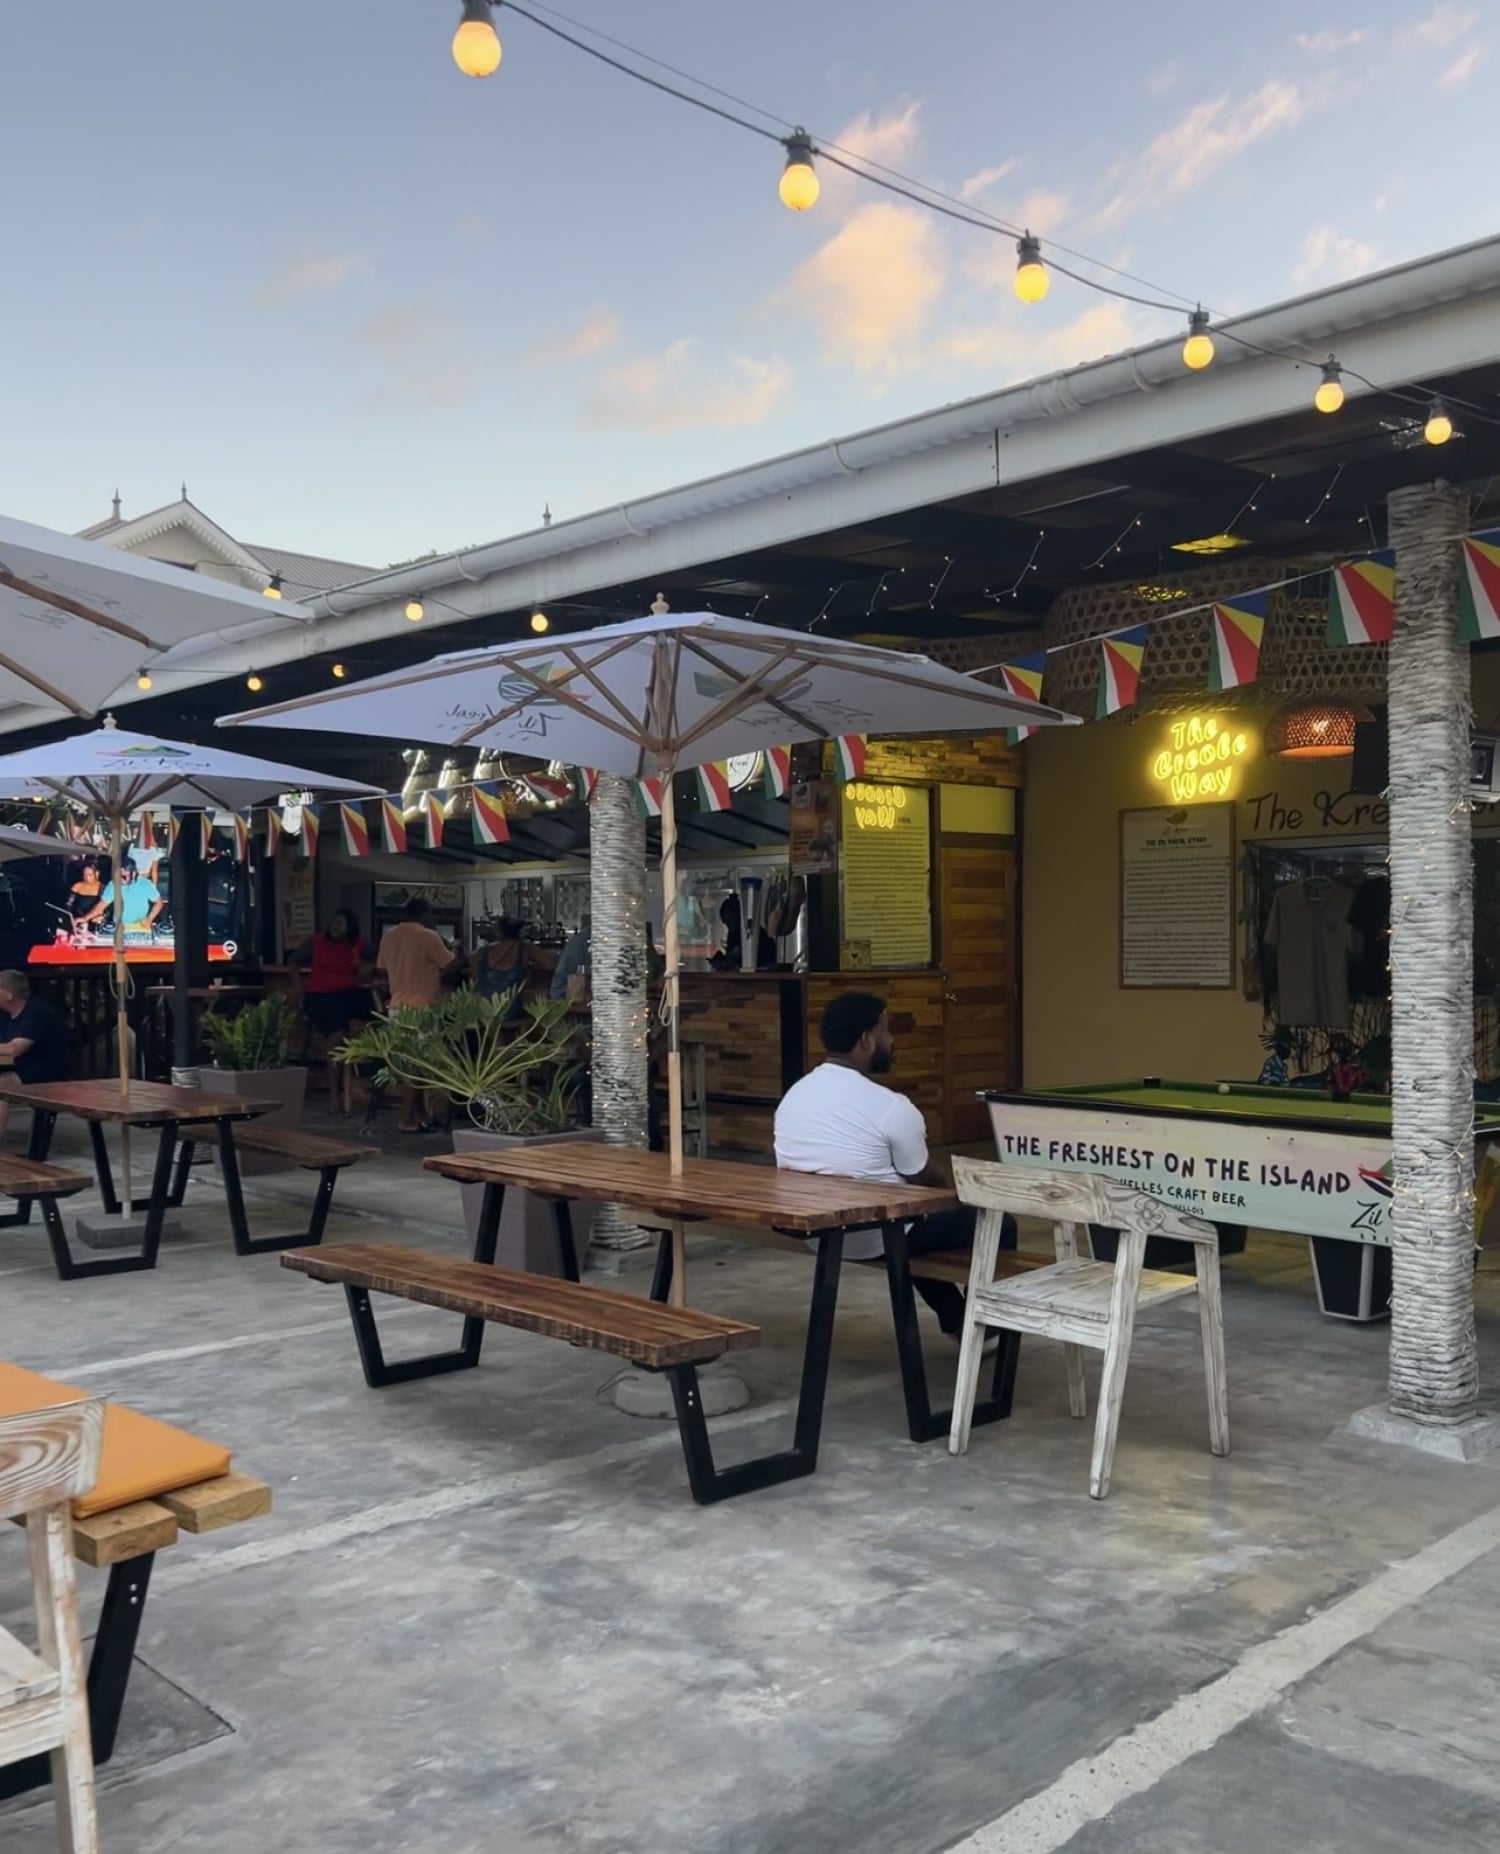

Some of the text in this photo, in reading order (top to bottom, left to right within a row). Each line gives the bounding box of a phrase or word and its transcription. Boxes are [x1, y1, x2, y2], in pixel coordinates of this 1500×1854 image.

[1170, 716, 1219, 751] The
[1153, 731, 1247, 780] Creole
[1170, 765, 1232, 802] Way
[1246, 791, 1390, 831] The Kre
[1003, 1134, 1351, 1196] THE FRESHEST ON THE ISLAND
[1167, 1185, 1208, 1201] CRAFT
[1212, 1190, 1247, 1208] BEER
[1350, 1199, 1384, 1234] Zil
